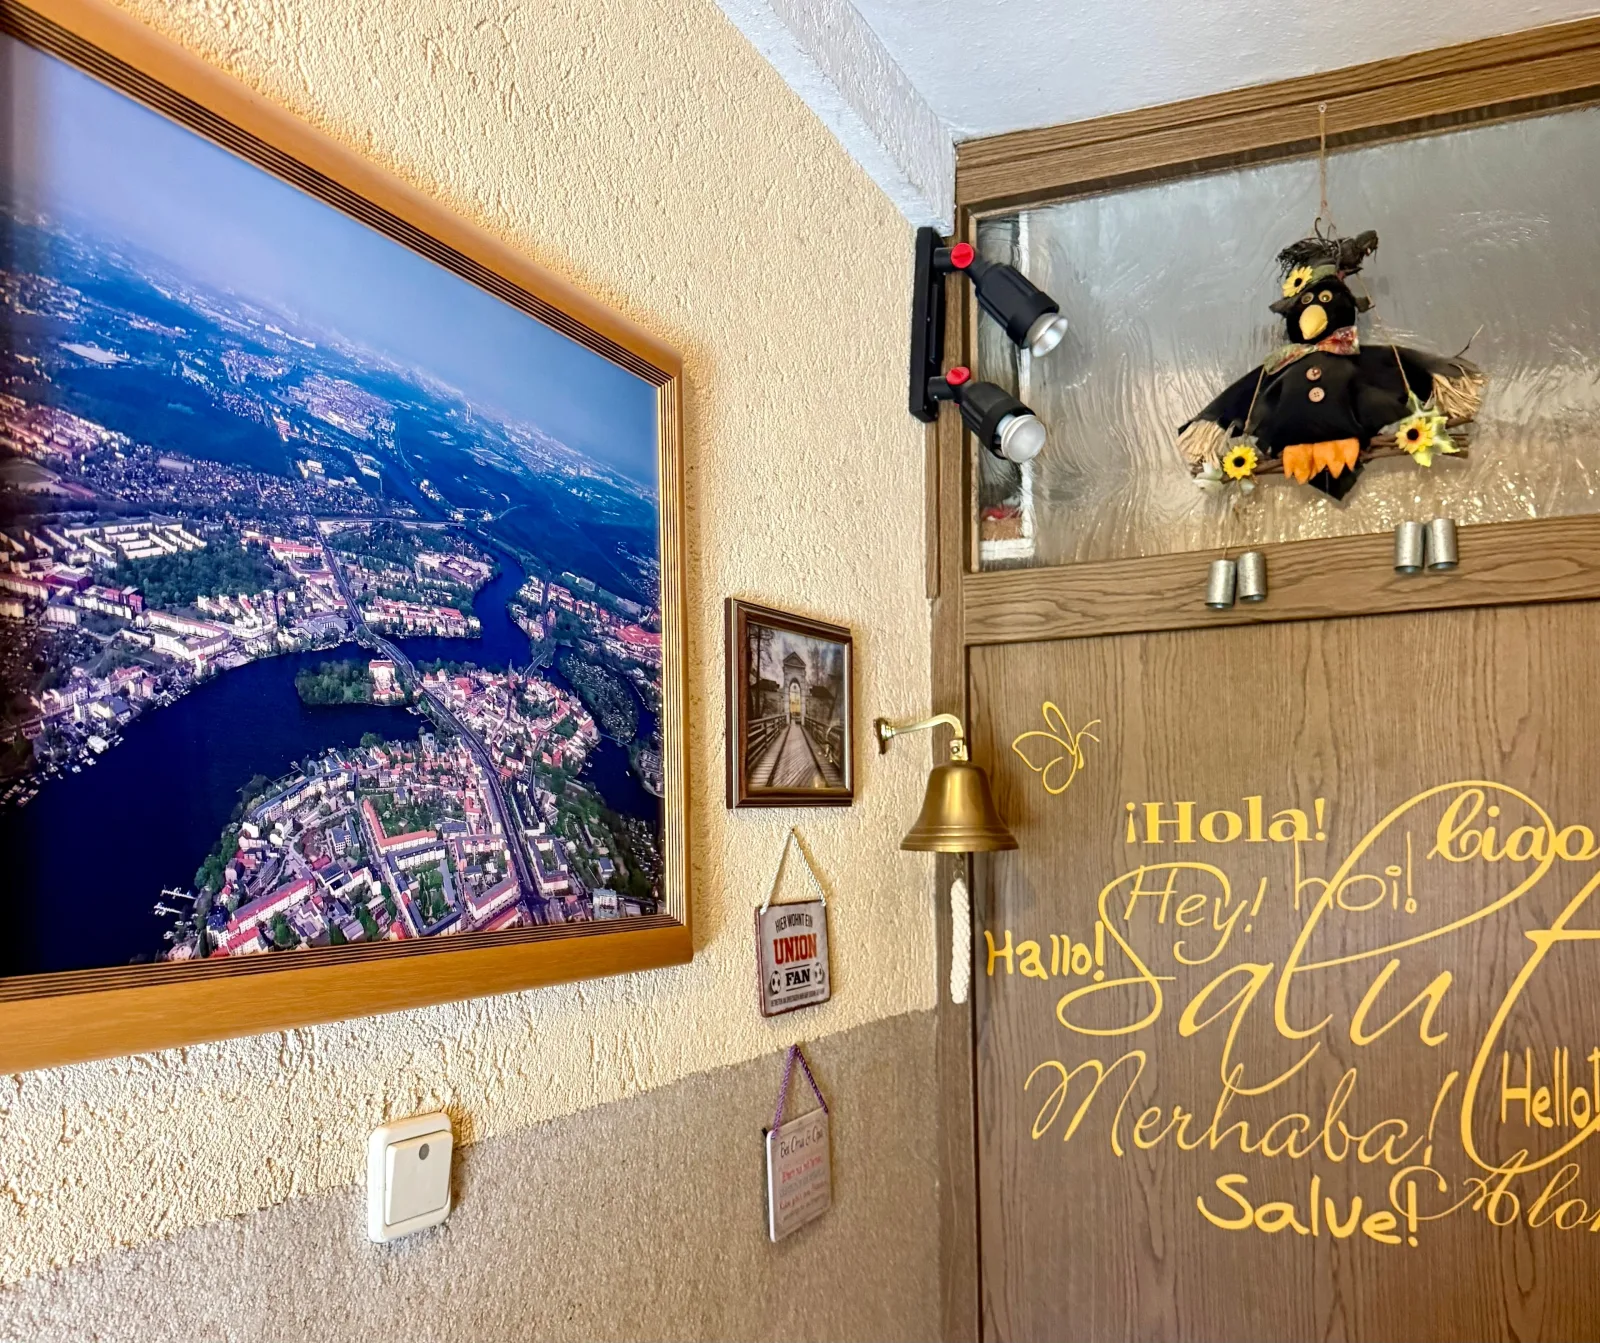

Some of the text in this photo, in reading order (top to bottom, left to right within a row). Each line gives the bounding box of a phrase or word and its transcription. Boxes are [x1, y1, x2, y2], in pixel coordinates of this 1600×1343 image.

[788, 914, 804, 928] WOHNT
[1123, 865, 1267, 964] Hey!
[773, 933, 817, 964] UNION
[786, 969, 810, 986] FAN
[984, 921, 1105, 981] Hallo!
[1024, 1049, 1459, 1165] Merhaba!
[1197, 1174, 1418, 1247] Salve!
